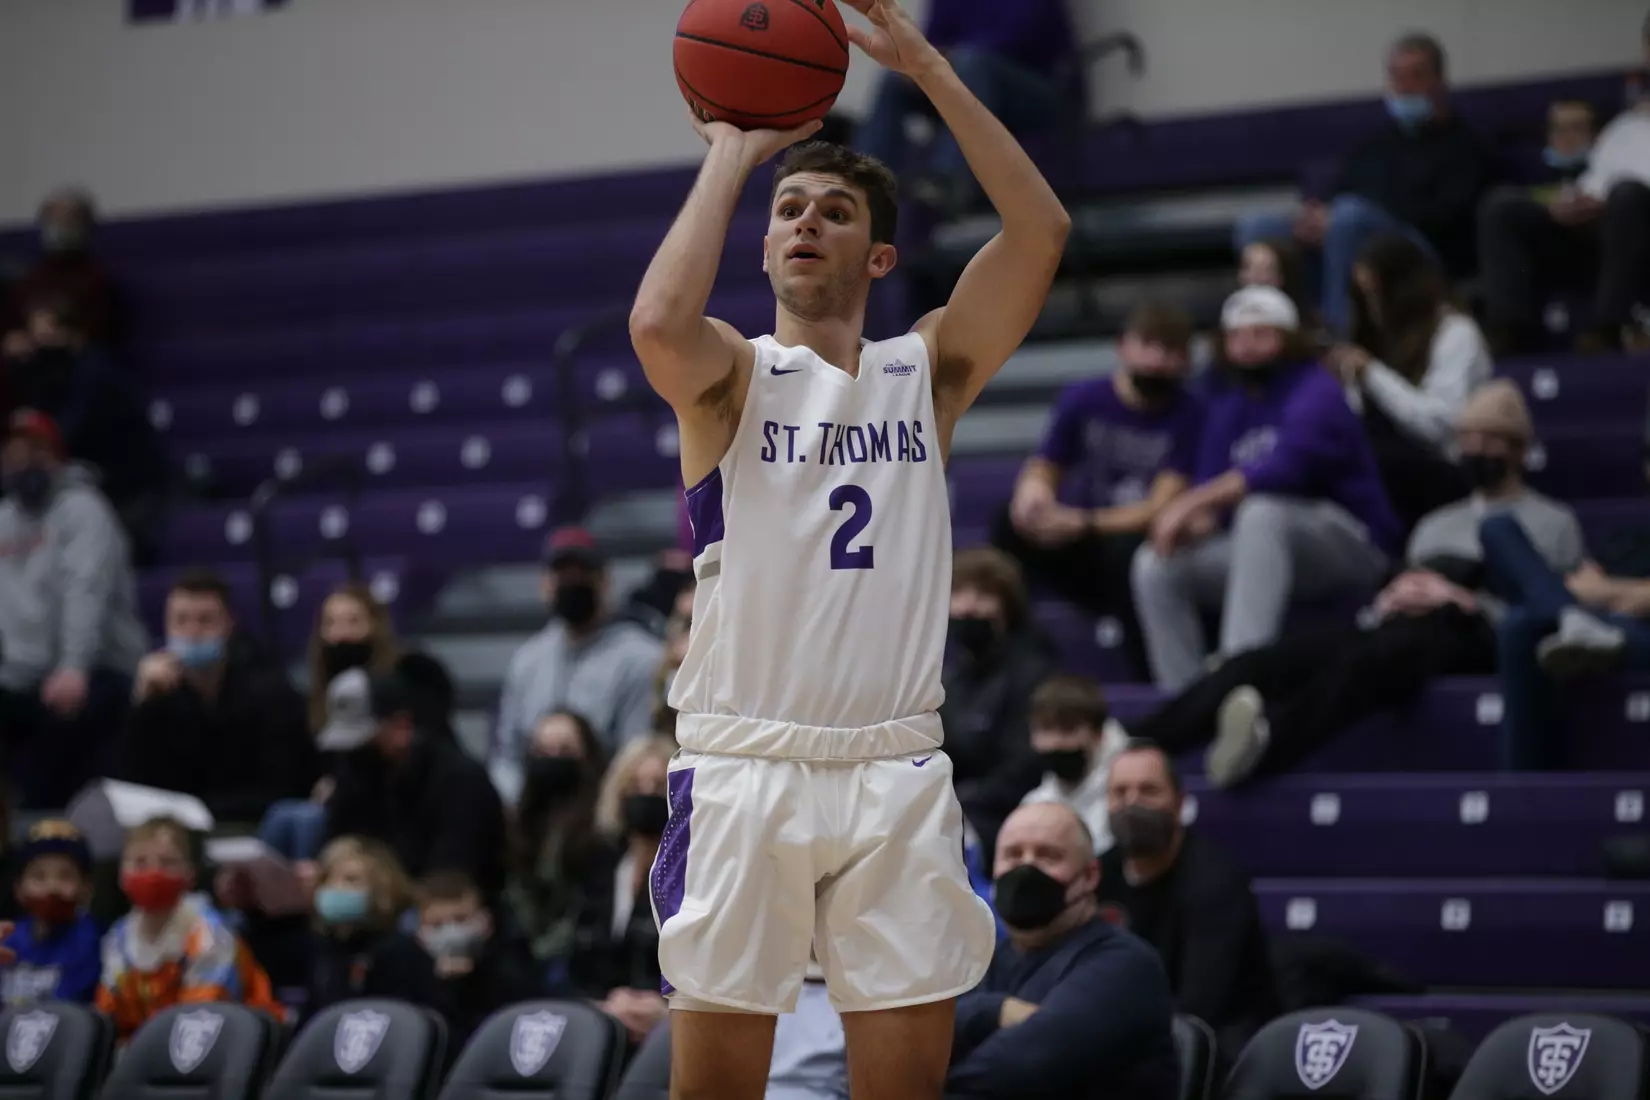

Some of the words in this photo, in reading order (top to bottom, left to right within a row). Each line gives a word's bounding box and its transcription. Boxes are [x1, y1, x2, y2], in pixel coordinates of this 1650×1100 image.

[883, 364, 916, 373] SUMMIT
[760, 420, 806, 464] ST.
[818, 420, 928, 466] THOMAS
[829, 484, 874, 570] 2
